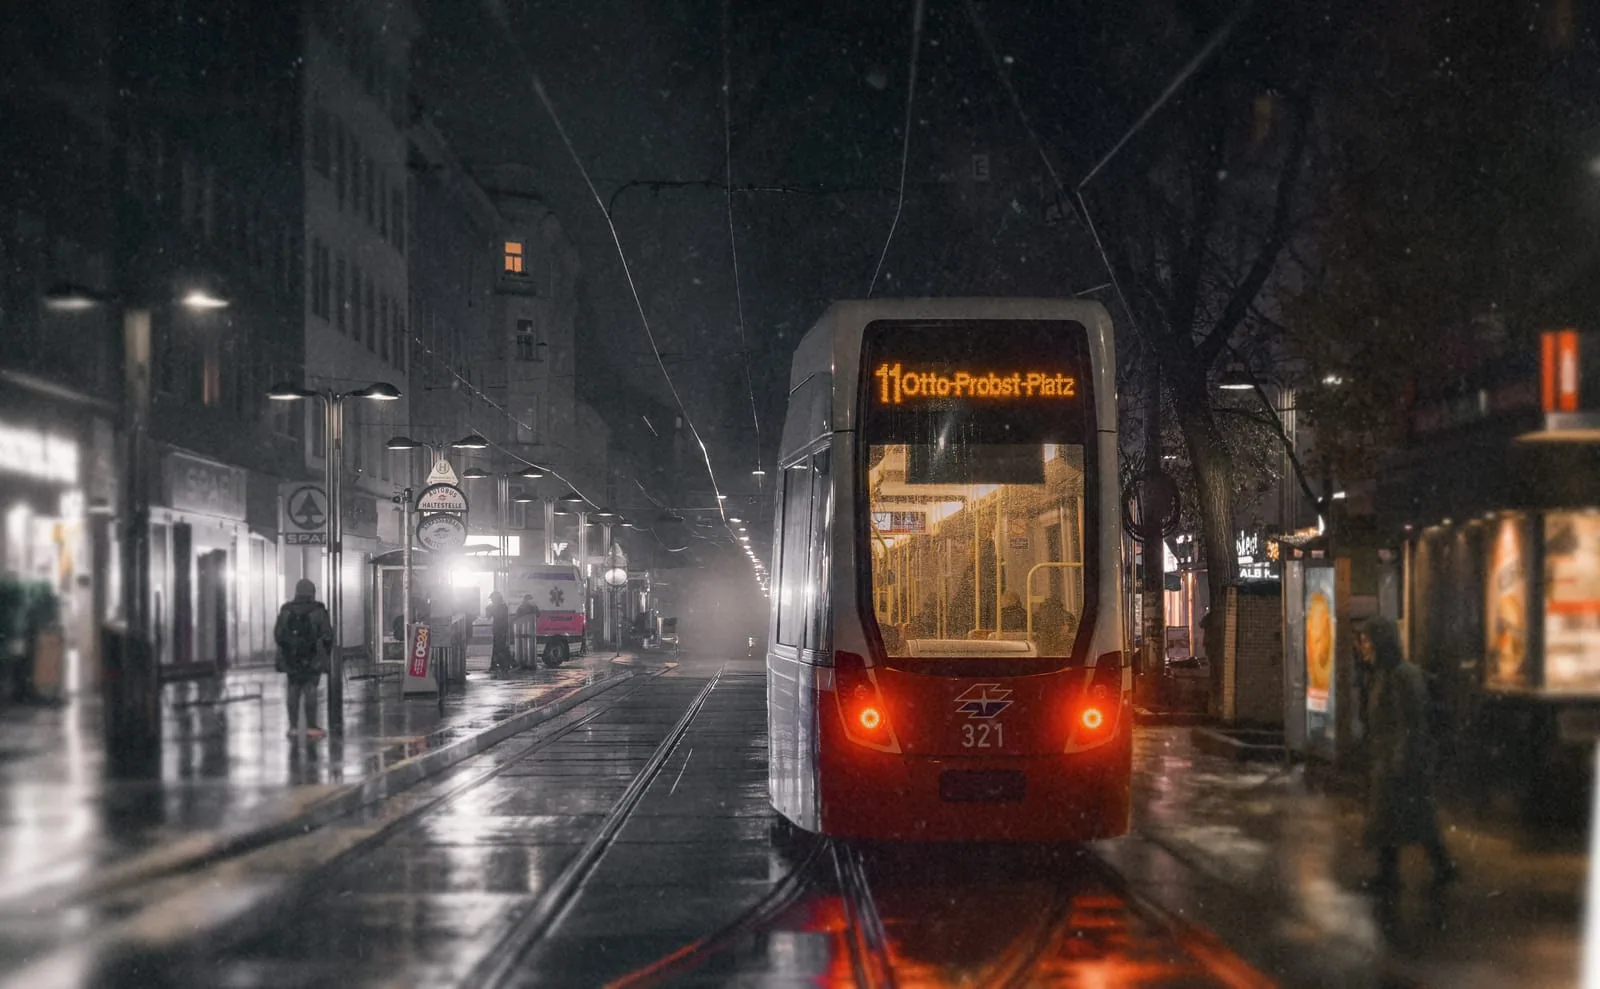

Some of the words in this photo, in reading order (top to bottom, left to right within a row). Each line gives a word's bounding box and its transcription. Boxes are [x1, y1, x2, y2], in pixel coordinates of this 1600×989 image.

[875, 362, 901, 404] 11
[902, 371, 1076, 397] Otto-Probst-Platz
[428, 487, 458, 498] AUTOBUS
[961, 723, 1005, 748] 321
